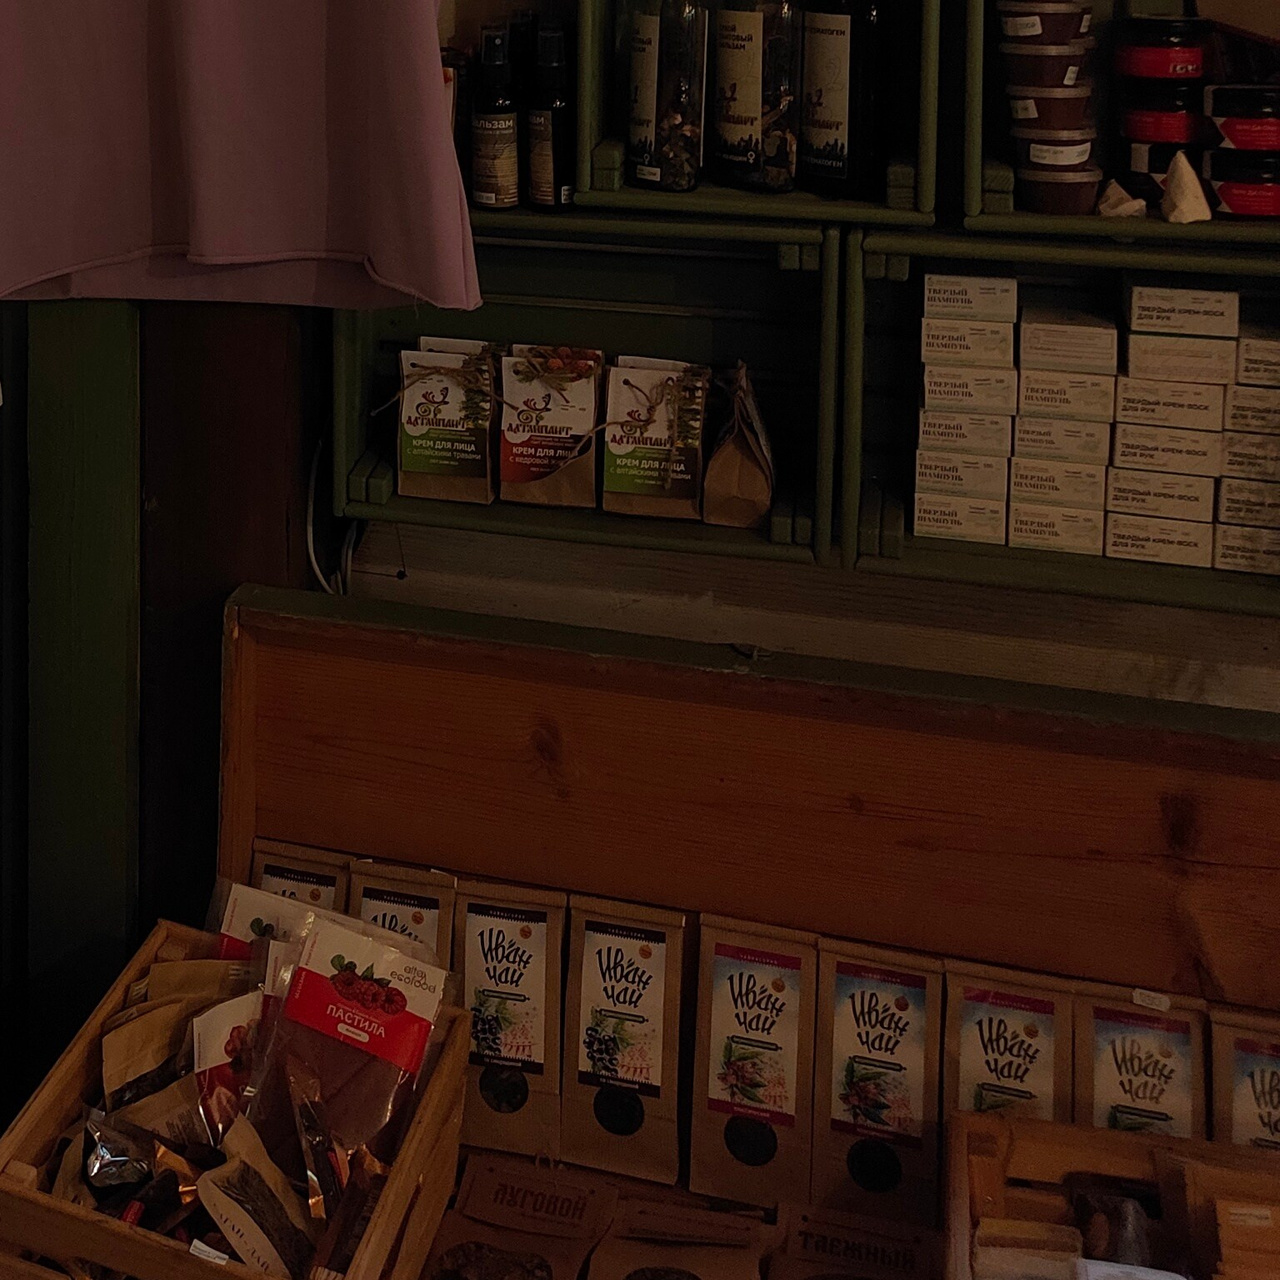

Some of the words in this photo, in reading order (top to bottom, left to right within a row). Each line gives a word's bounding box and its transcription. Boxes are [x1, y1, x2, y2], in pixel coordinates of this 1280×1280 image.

[412, 439, 434, 450] КРЕМ
[434, 440, 452, 451] ДЛЯ
[453, 442, 476, 453] ЛИЦА
[512, 446, 535, 456] КРЕМ
[536, 447, 555, 458] ДЛЯ
[616, 457, 640, 468] КРЕМ
[640, 458, 660, 470] ДЛЯ
[478, 928, 534, 970] Иван
[486, 966, 525, 988] чай
[596, 946, 653, 991] Иван
[390, 970, 437, 994] ecofood
[602, 985, 644, 1009] чай
[728, 972, 786, 1018] Иван
[326, 1004, 386, 1039] ПАСТИЛА
[734, 1012, 777, 1035] чай
[849, 990, 910, 1036] Иван
[856, 1030, 900, 1055] чай
[976, 1016, 1040, 1064] Иван
[984, 1058, 1030, 1083] чай
[1110, 1038, 1175, 1086] Иван
[1120, 1078, 1166, 1104] чай
[493, 1181, 589, 1222] ЛУГОВОЙ
